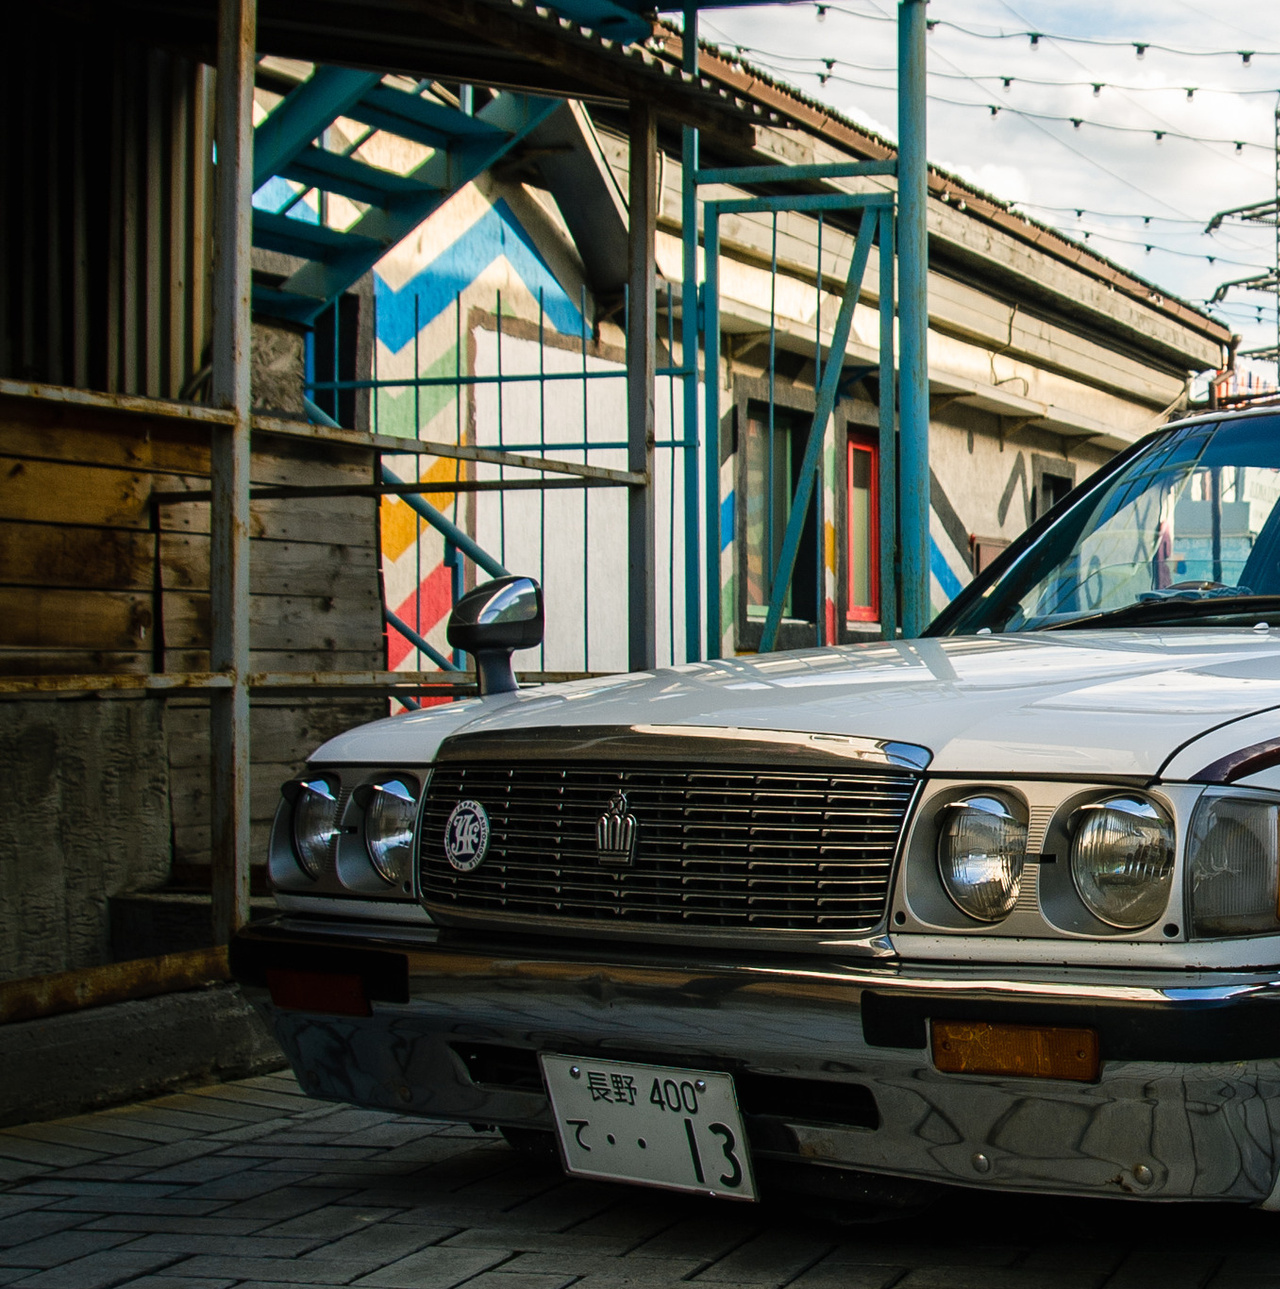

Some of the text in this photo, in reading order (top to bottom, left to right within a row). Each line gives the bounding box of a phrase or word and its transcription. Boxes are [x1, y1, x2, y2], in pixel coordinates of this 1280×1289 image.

[456, 803, 477, 813] JAPAN
[587, 1072, 698, 1114] 長野 400
[566, 1119, 591, 1152] て
